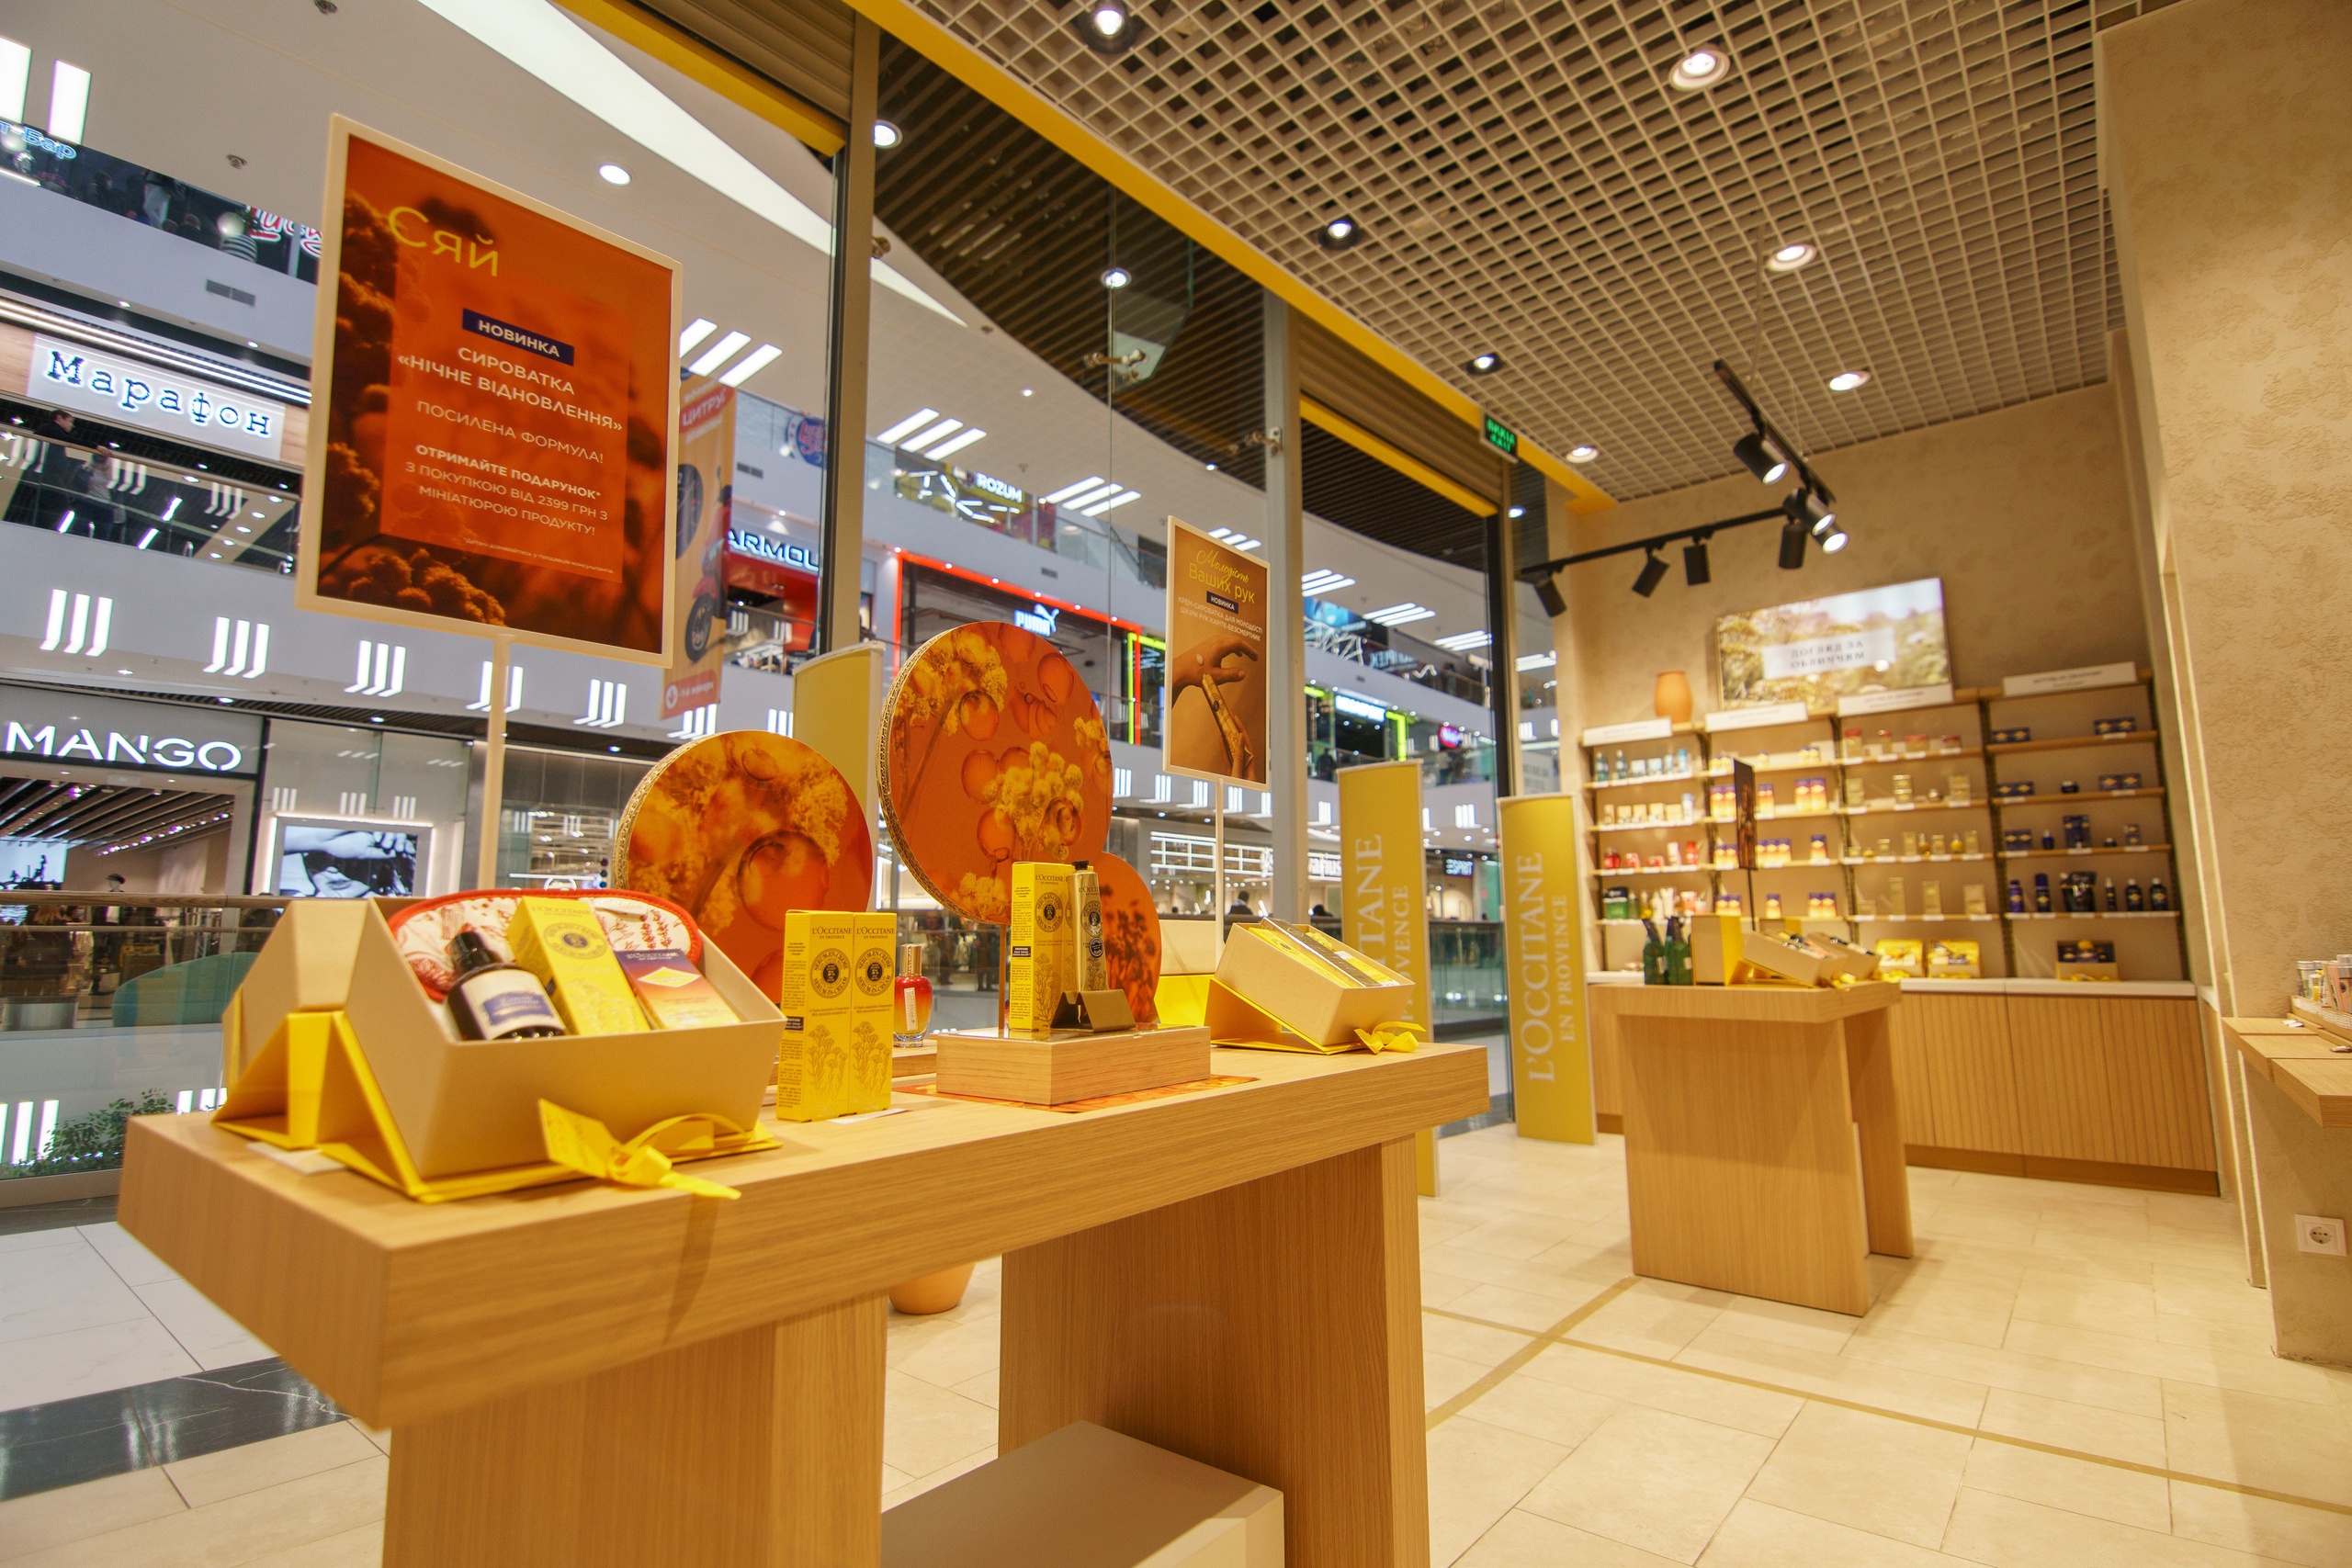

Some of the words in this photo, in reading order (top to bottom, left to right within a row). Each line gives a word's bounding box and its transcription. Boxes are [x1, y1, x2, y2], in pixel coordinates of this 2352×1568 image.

[389, 207, 499, 277] Сяй
[479, 320, 560, 357] НОВИНКА
[47, 351, 270, 435] Марафон
[398, 355, 472, 386] «НІЧНЕ
[478, 376, 623, 431] ВІДНОВЛЕННЯ»
[458, 347, 575, 395] СИРОВАТКА
[417, 400, 516, 439] ПОСИЛЕНА
[521, 432, 605, 464] ФОРМУЛА!
[415, 445, 508, 477] ОТРИМАЙТЕ
[419, 486, 518, 517] МІНІАТЮРОЮ
[521, 510, 595, 536] ПРОДУКТУ!
[420, 465, 506, 494] ПОКУПКОЮ
[510, 489, 535, 504] ВІД
[537, 495, 569, 511] 2399
[572, 503, 597, 518] ГРН
[976, 472, 1023, 503] ROZUM
[1189, 562, 1231, 594] Ваших
[1234, 585, 1255, 604] рук
[1210, 595, 1236, 611] НОВИНКА
[1014, 609, 1051, 637] PUMA
[4, 721, 243, 771] MANGO
[812, 926, 853, 935] L'OCCITANE
[856, 926, 896, 935] L'OCCITANE
[1552, 895, 1573, 1007] PROVENCE
[1517, 852, 1555, 1082] L'OCCITANE
[1561, 1014, 1576, 1042] EN
